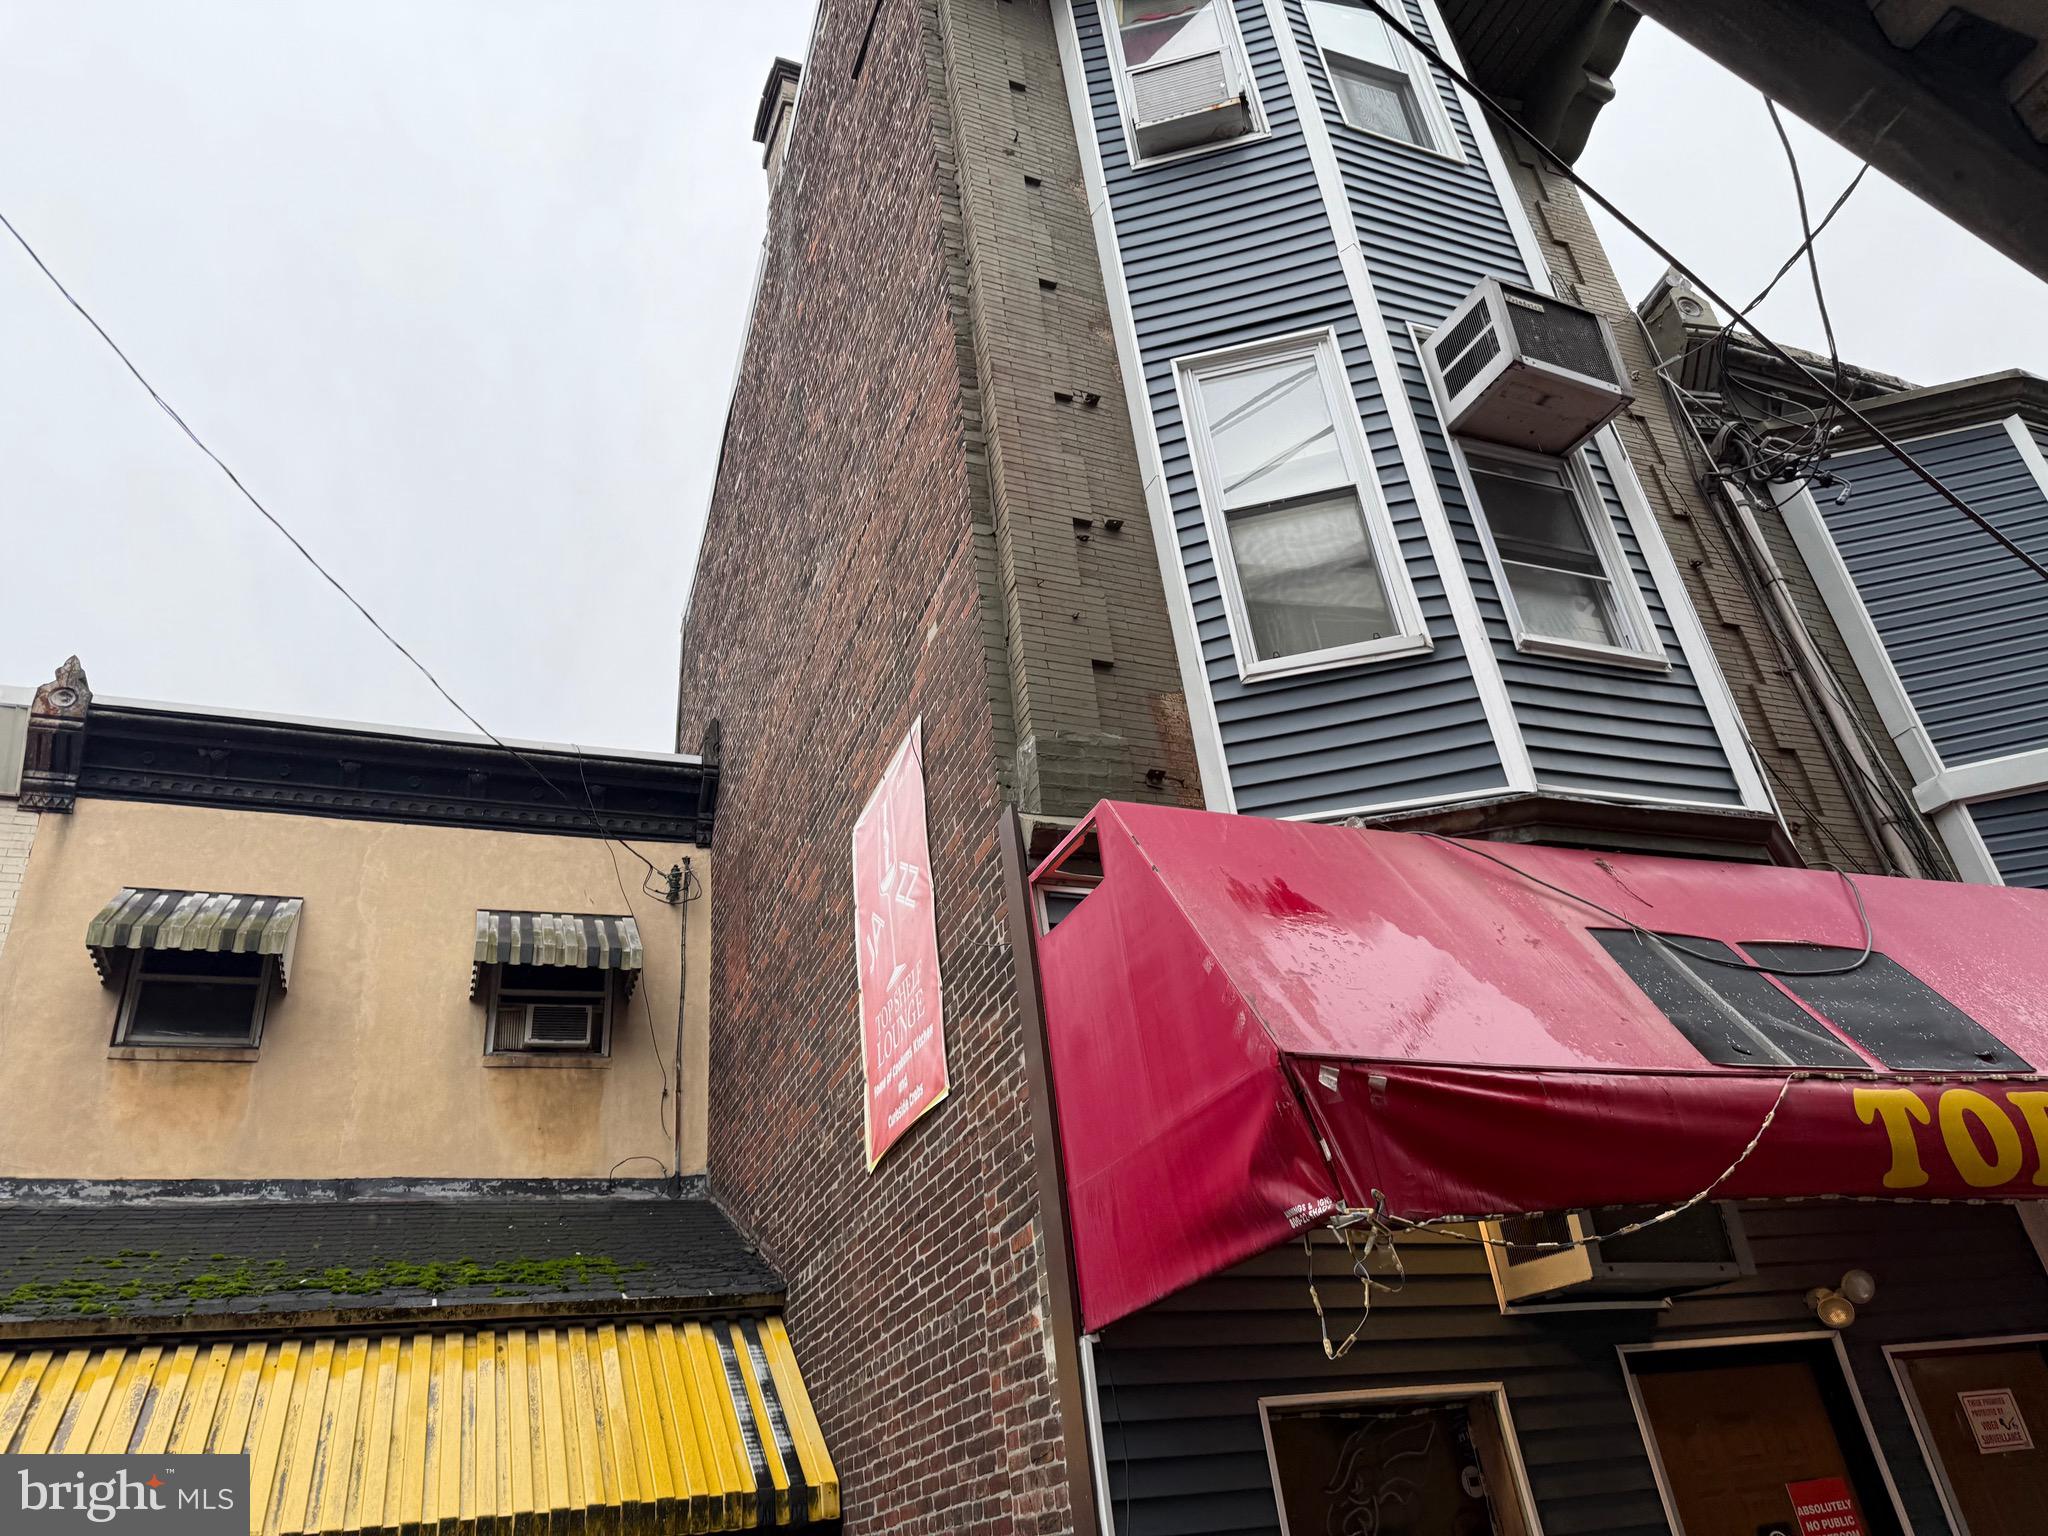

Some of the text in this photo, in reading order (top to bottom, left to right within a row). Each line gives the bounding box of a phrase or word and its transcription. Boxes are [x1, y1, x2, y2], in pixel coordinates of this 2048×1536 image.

[875, 959, 922, 1035] TOP SHELF
[877, 987, 926, 1070] LOUNGE
[1797, 1499, 1852, 1516] ABSOLUTELY
[1805, 1521, 1820, 1533] NO
[1821, 1515, 1856, 1530] PUBLIC
